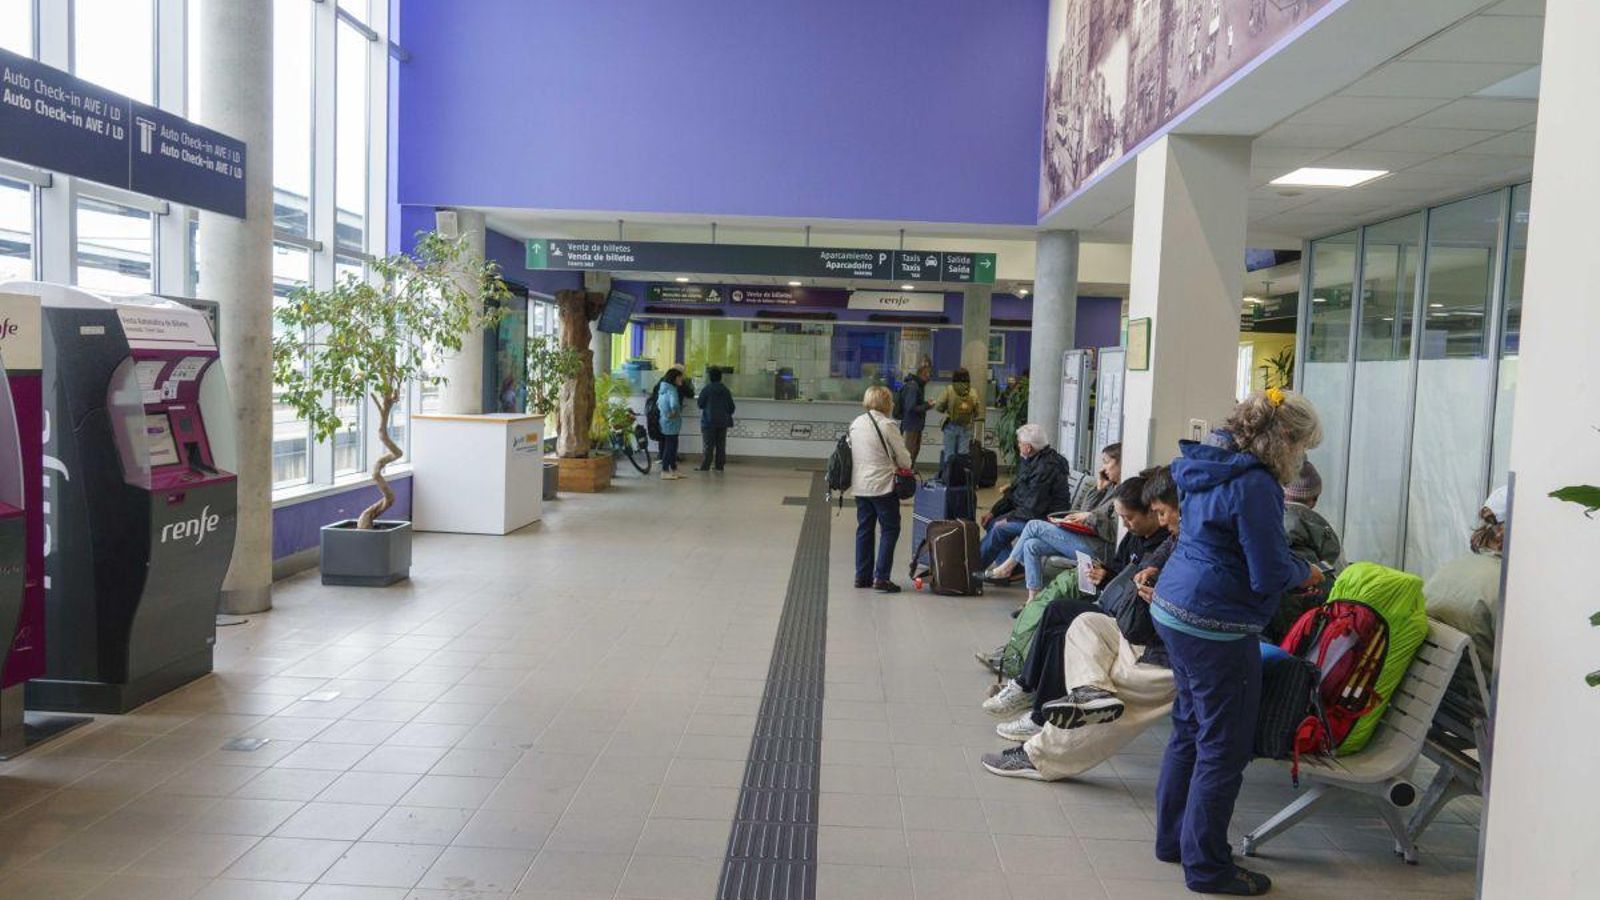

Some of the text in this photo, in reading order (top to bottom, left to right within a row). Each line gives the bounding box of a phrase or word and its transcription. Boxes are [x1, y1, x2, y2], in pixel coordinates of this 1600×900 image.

[3, 67, 30, 90] Auto
[34, 79, 81, 107] Check-in
[83, 97, 101, 115] AVE
[110, 106, 121, 121] LD
[3, 88, 31, 110] Auto
[35, 99, 82, 127] Check-in
[85, 116, 103, 134] AVE
[112, 124, 124, 140] LD
[160, 124, 179, 142] Auto
[180, 132, 213, 154] Check-in
[160, 142, 180, 159] Auto
[181, 149, 214, 171] Check-in
[567, 242, 631, 253] Venta de billetes
[567, 252, 635, 262] Venda de billetes
[820, 251, 873, 260] Aparcamiento
[902, 253, 920, 262] Taxis
[947, 255, 970, 264] Salida
[825, 261, 873, 270] Aparcadoiro
[901, 263, 921, 271] Taxis
[879, 296, 910, 306] renfe
[161, 504, 220, 546] renfe
